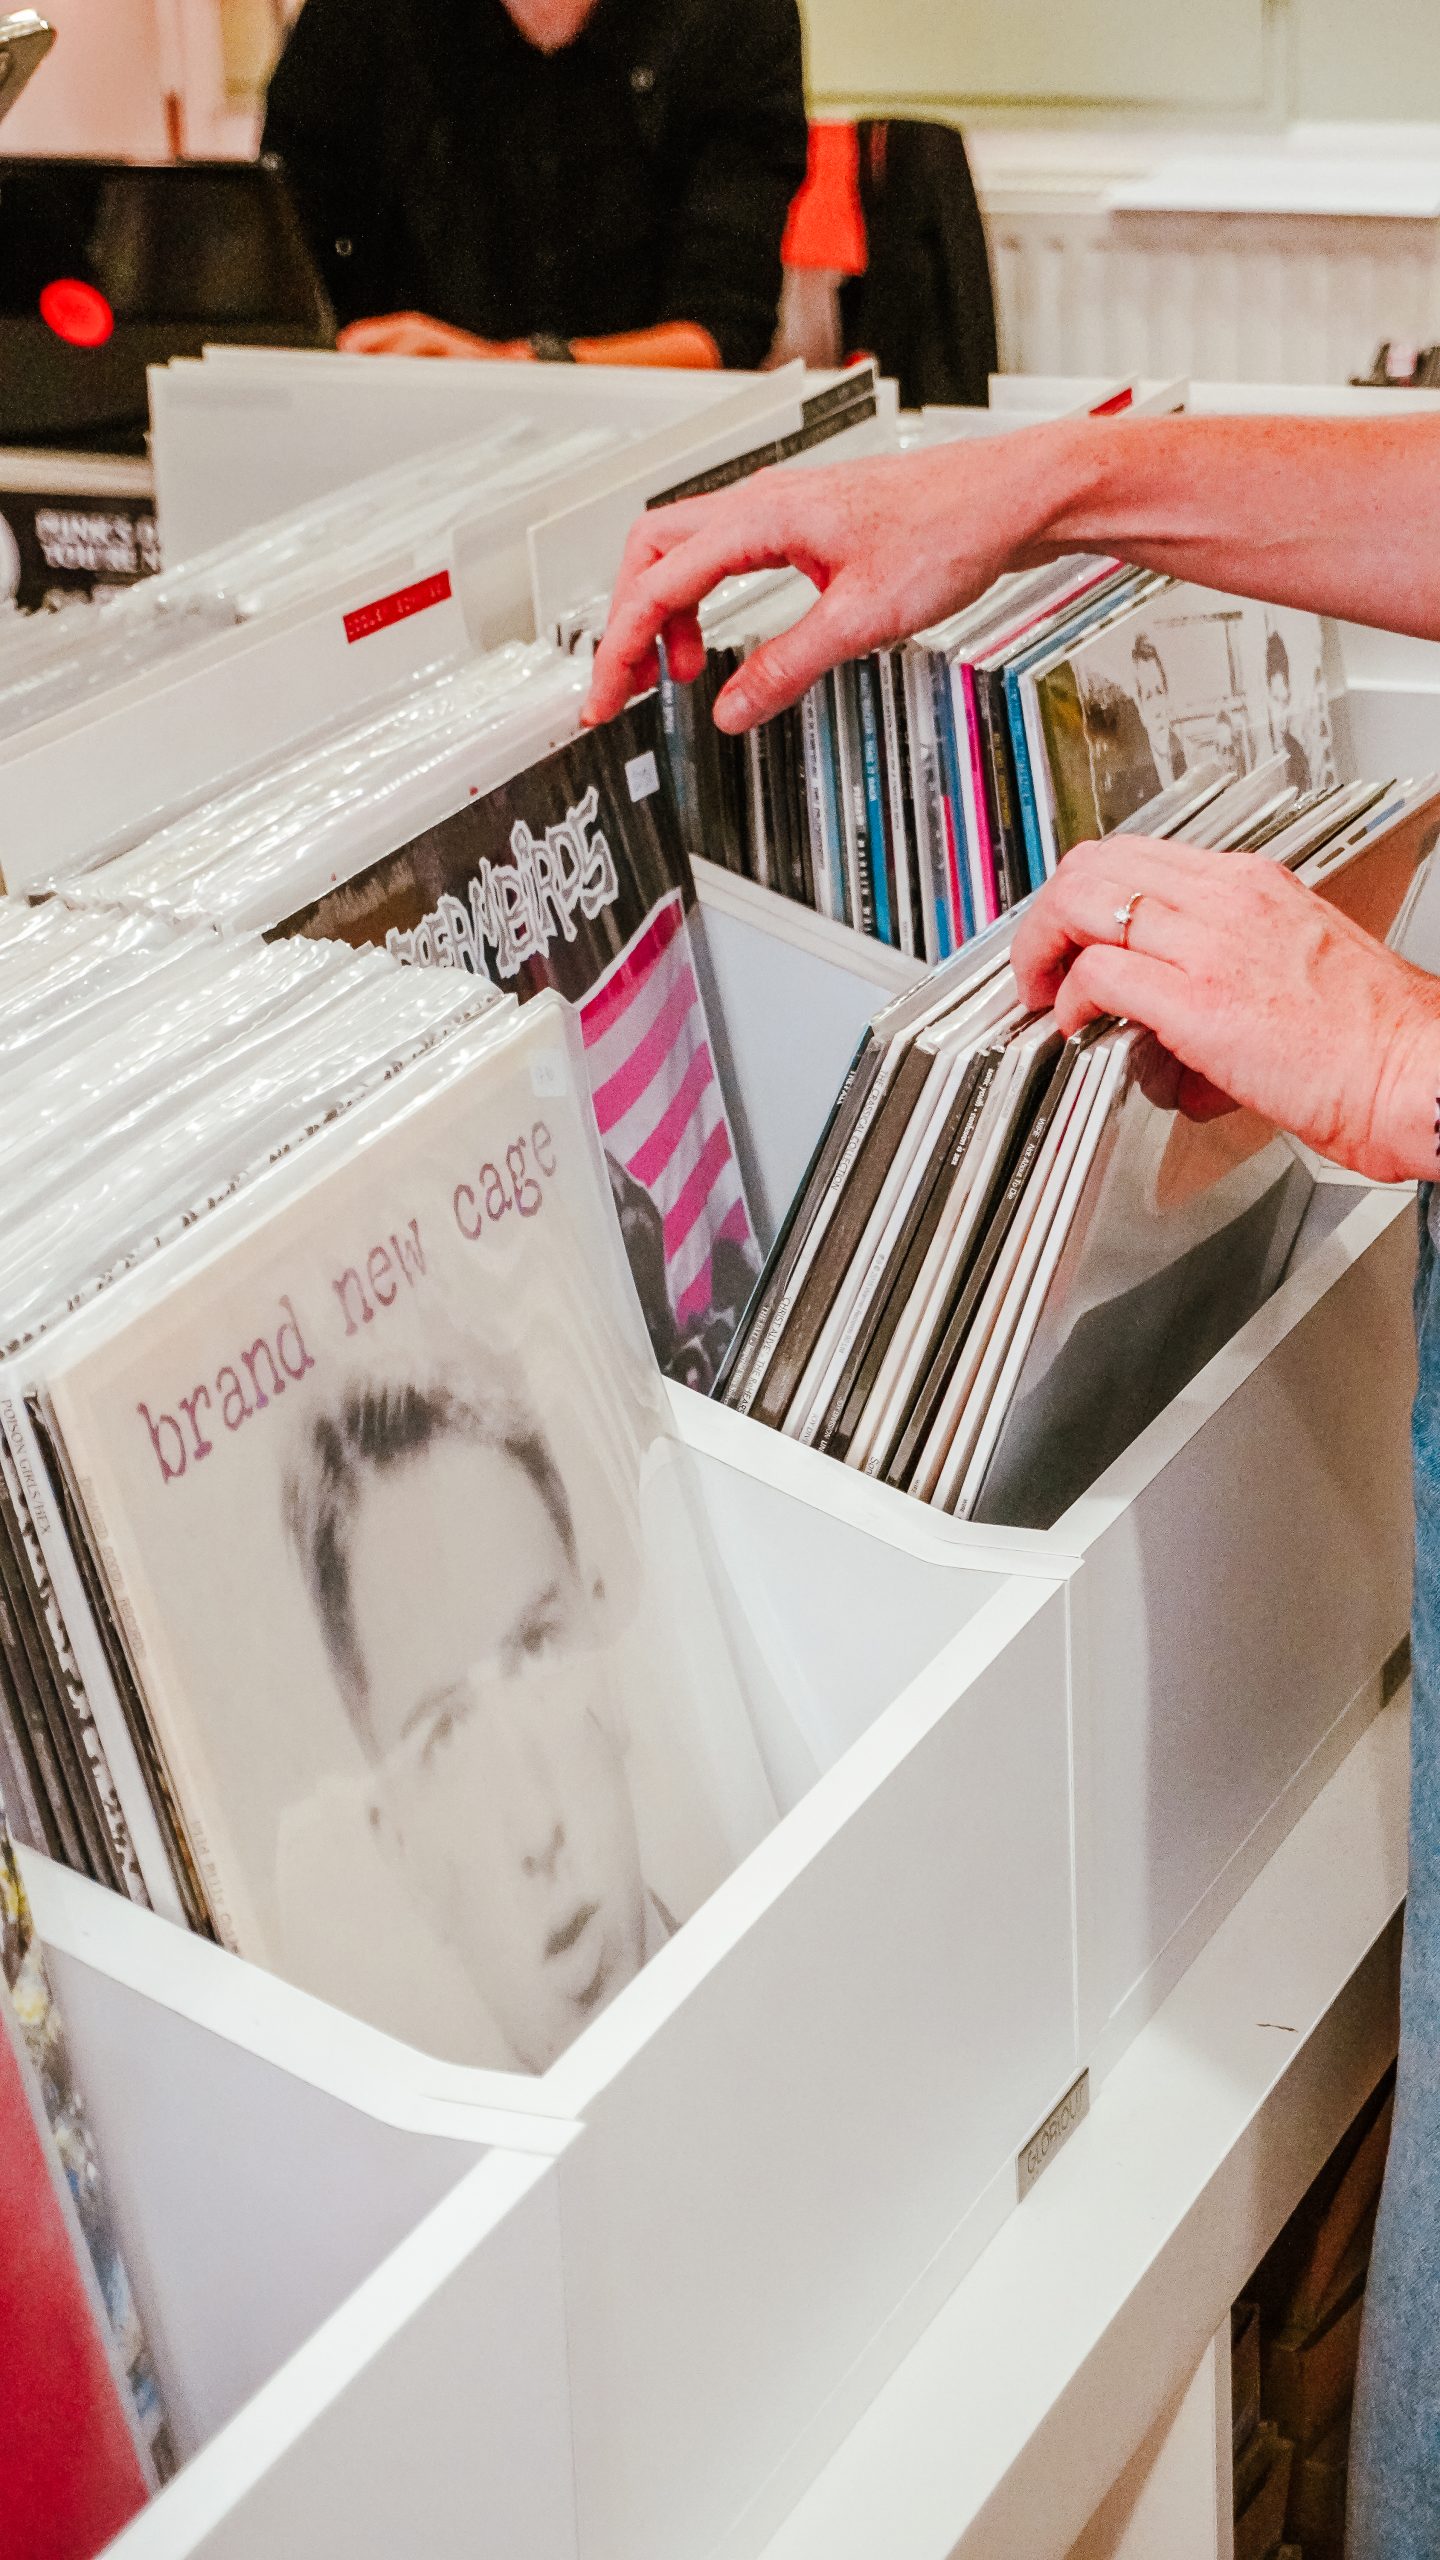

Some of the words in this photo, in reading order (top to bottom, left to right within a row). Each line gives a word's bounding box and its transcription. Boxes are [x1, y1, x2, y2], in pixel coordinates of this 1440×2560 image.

[857, 1086, 882, 1134] CRASSICAL
[959, 1112, 977, 1147] confusion
[831, 1135, 861, 1191] COLLECTION
[136, 1294, 315, 1485] brand
[331, 1218, 427, 1337] new
[453, 1120, 558, 1241] cage
[2, 1399, 27, 1455] POISON
